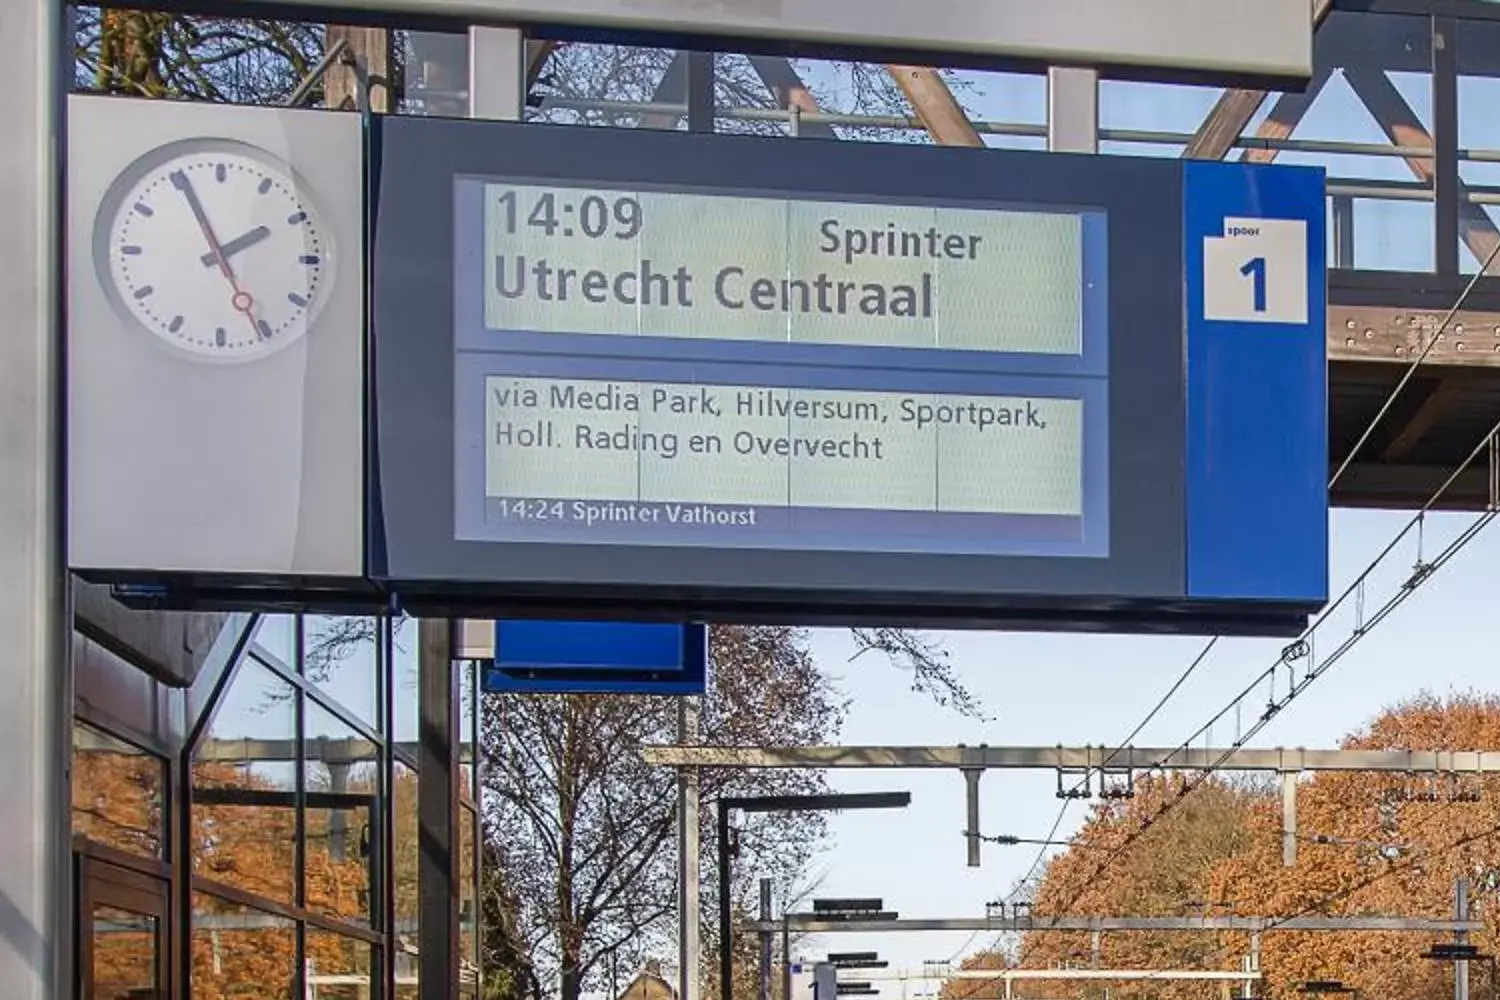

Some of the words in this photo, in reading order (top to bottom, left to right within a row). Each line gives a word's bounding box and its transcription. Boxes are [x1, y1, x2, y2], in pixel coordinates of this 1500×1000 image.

[498, 191, 643, 240] 14:09
[820, 219, 982, 264] Sprinter
[1228, 226, 1260, 237] spoor
[495, 255, 693, 307] Utrecht
[714, 266, 933, 318] Centraal
[1239, 257, 1267, 312] 1
[494, 381, 538, 408] via
[550, 384, 639, 411] Media
[652, 387, 722, 416] Park,
[736, 390, 888, 423] Hilversum,
[900, 398, 1047, 432] Sportpark,
[495, 420, 562, 449] Holl.
[575, 424, 678, 459] Rading
[689, 435, 722, 454] en
[733, 431, 884, 460] Overvecht
[500, 500, 565, 520] 14:24
[572, 501, 660, 526] Sprinter
[665, 504, 756, 526] Vathorst
